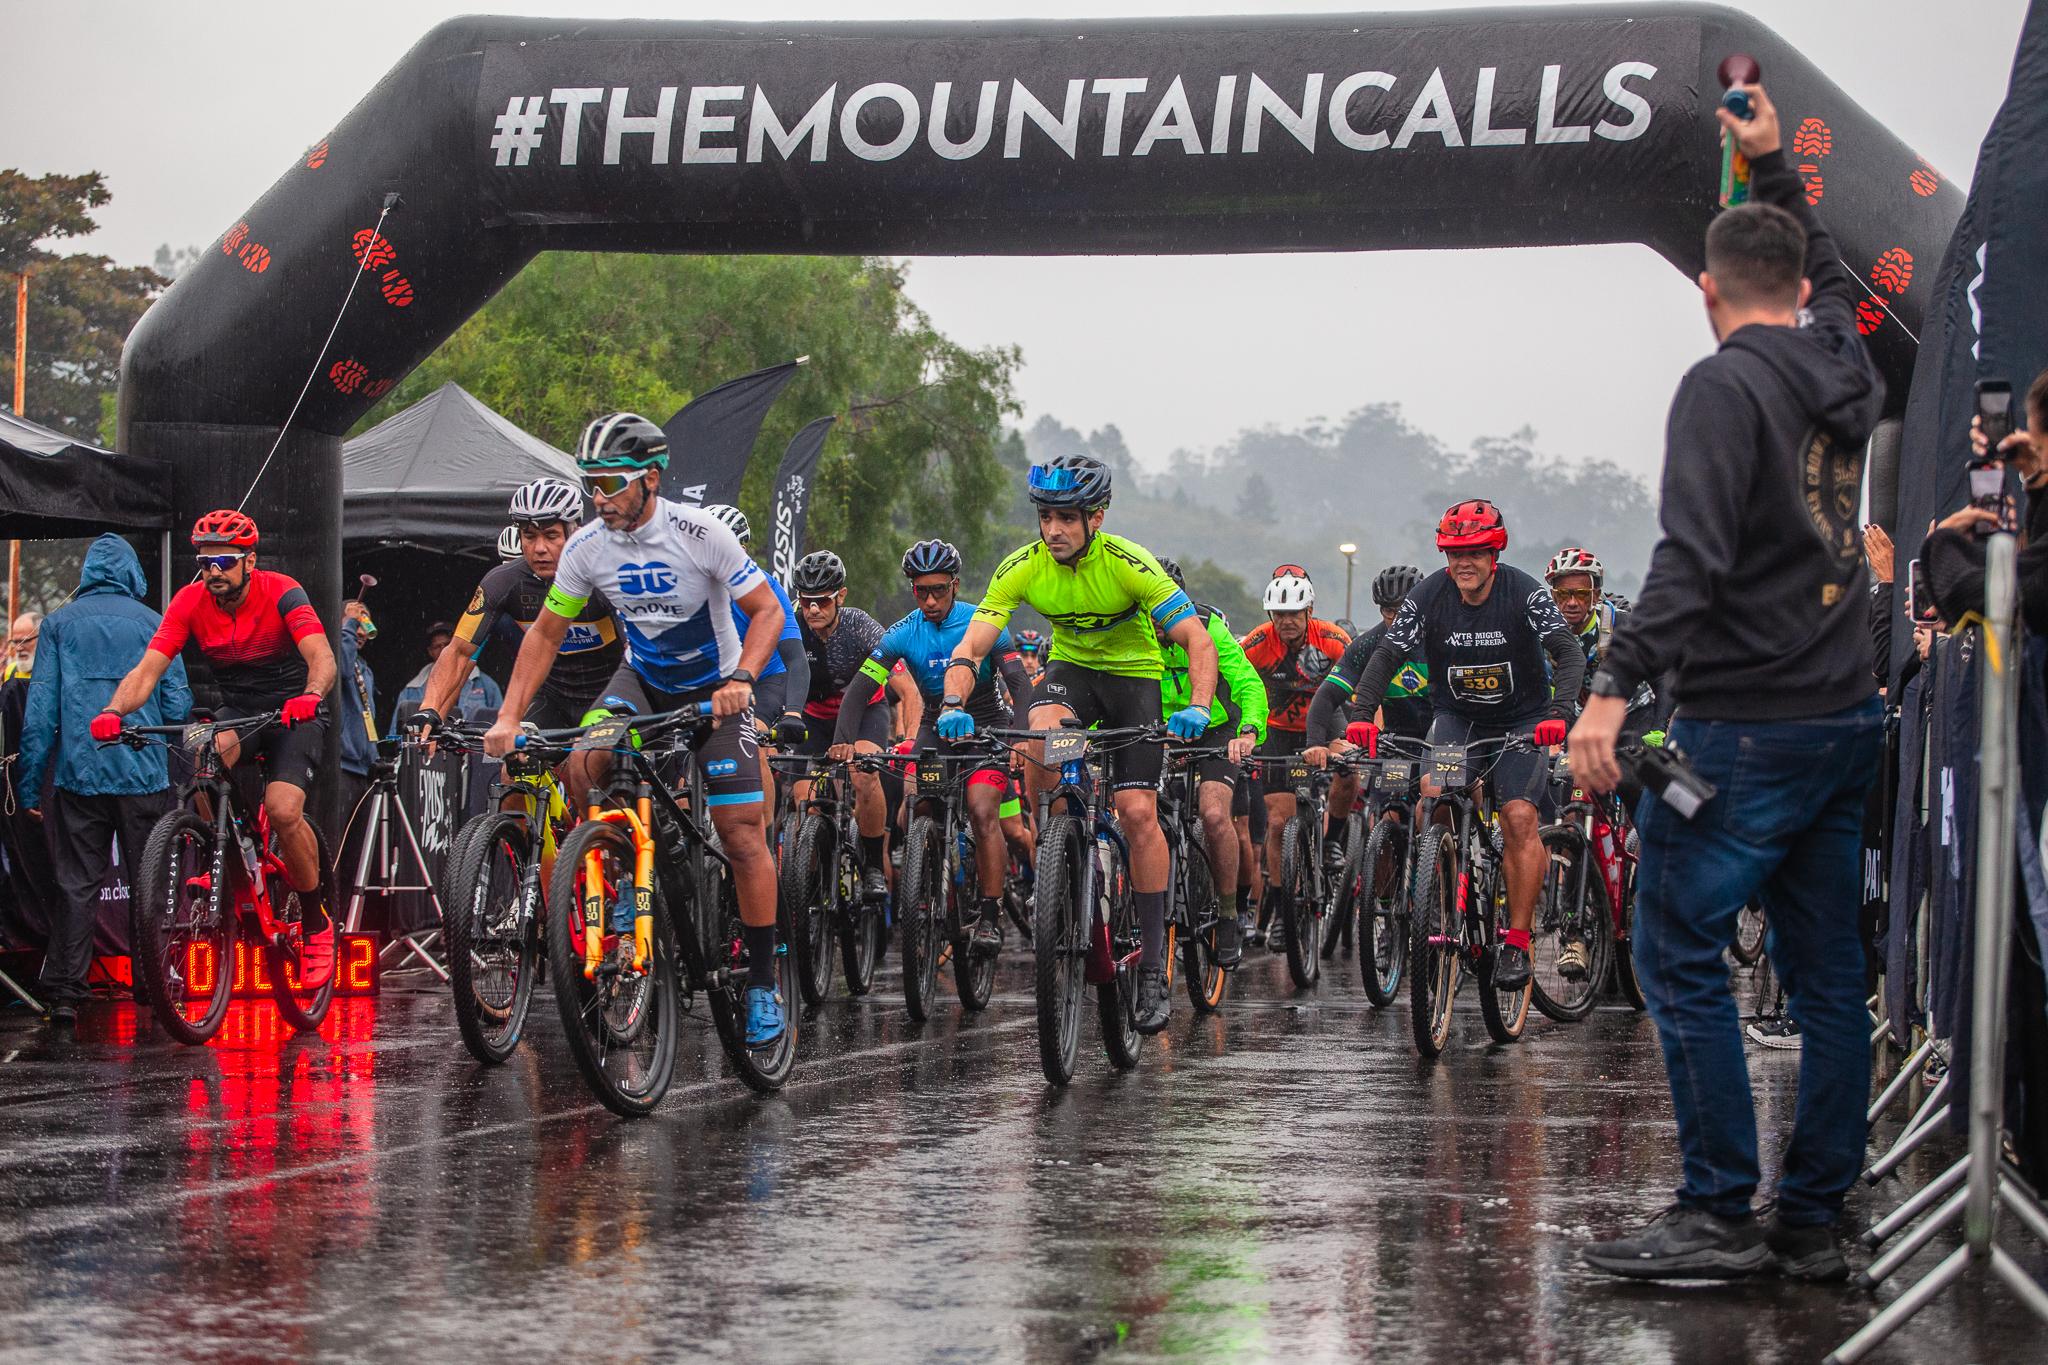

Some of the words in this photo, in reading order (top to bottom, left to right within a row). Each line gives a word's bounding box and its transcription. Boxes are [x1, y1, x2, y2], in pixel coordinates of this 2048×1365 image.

[489, 61, 1658, 167] #THEMOUNTAINCALLS
[1463, 677, 1499, 690] 530
[1052, 739, 1078, 749] 507
[921, 772, 940, 782] 551
